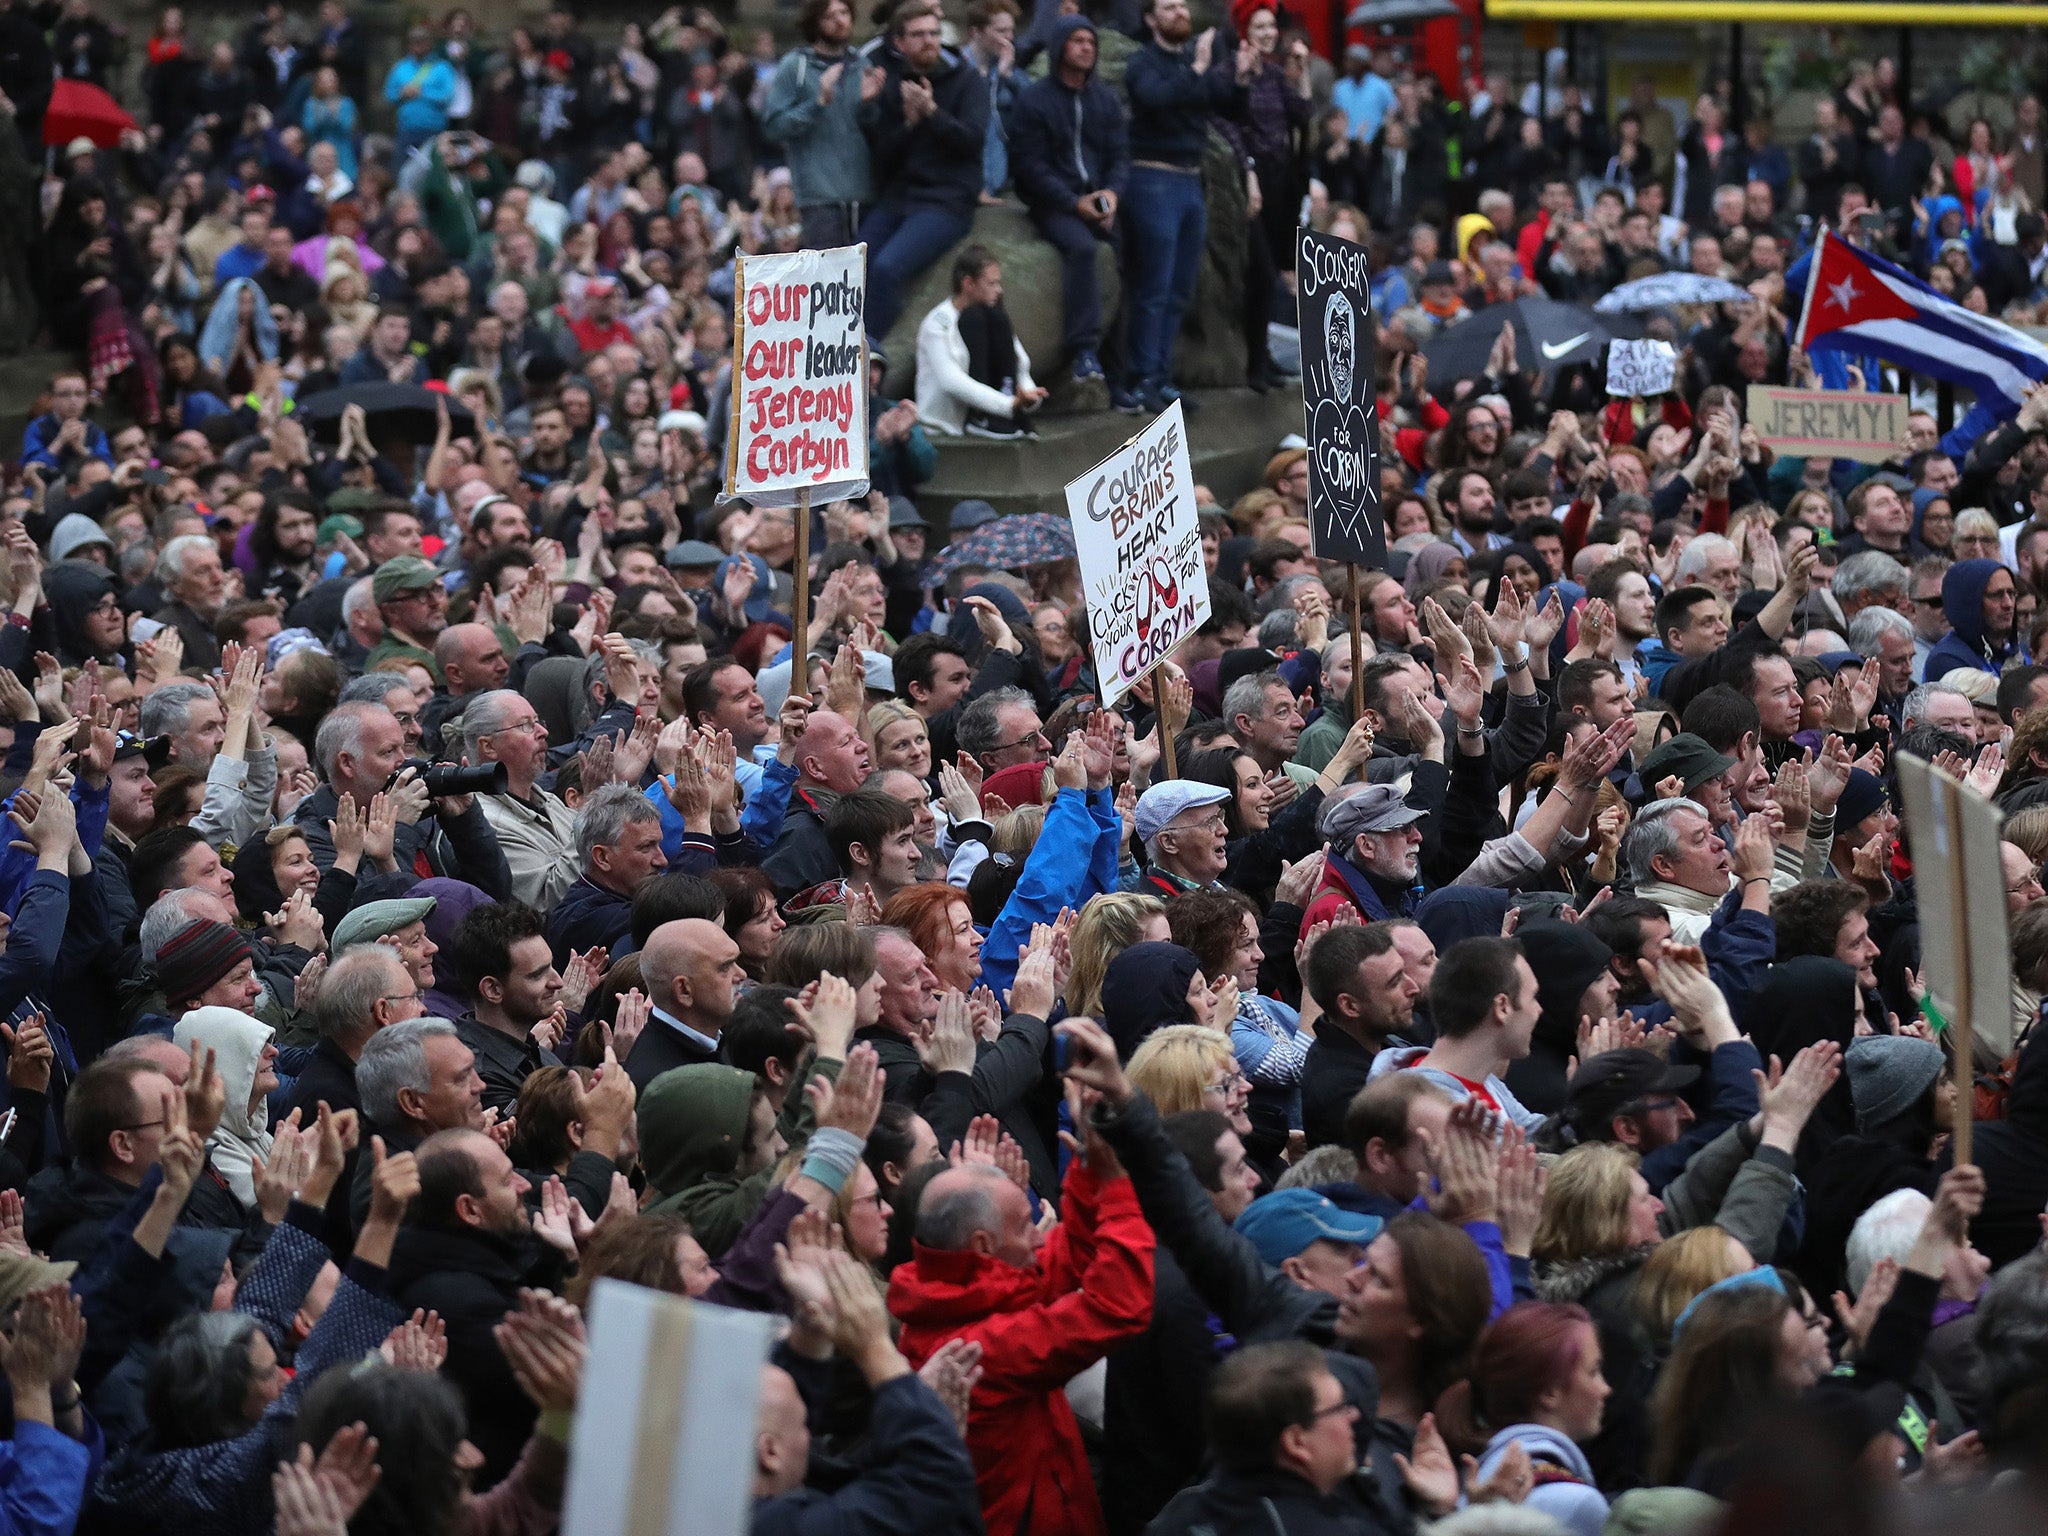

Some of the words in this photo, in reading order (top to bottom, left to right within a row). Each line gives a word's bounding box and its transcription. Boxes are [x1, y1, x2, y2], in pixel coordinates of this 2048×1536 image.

[809, 269, 862, 331] party
[1302, 235, 1369, 316] SCOUSERS
[805, 330, 860, 380] leader
[748, 380, 853, 433] Jeremy
[1765, 401, 1895, 441] JEREMY!
[747, 428, 849, 483] Corbyn
[1333, 428, 1351, 446] FOR
[1087, 422, 1179, 522] COURAGE
[1319, 437, 1365, 500] CORBYN
[1110, 460, 1175, 540] BRAINS
[1118, 495, 1178, 573] HEART
[1174, 523, 1202, 561] HEELS
[1181, 551, 1199, 590] FOR
[1093, 583, 1132, 639] CLICK
[1105, 613, 1133, 657] YOUR
[1119, 594, 1195, 682] CORBYN
